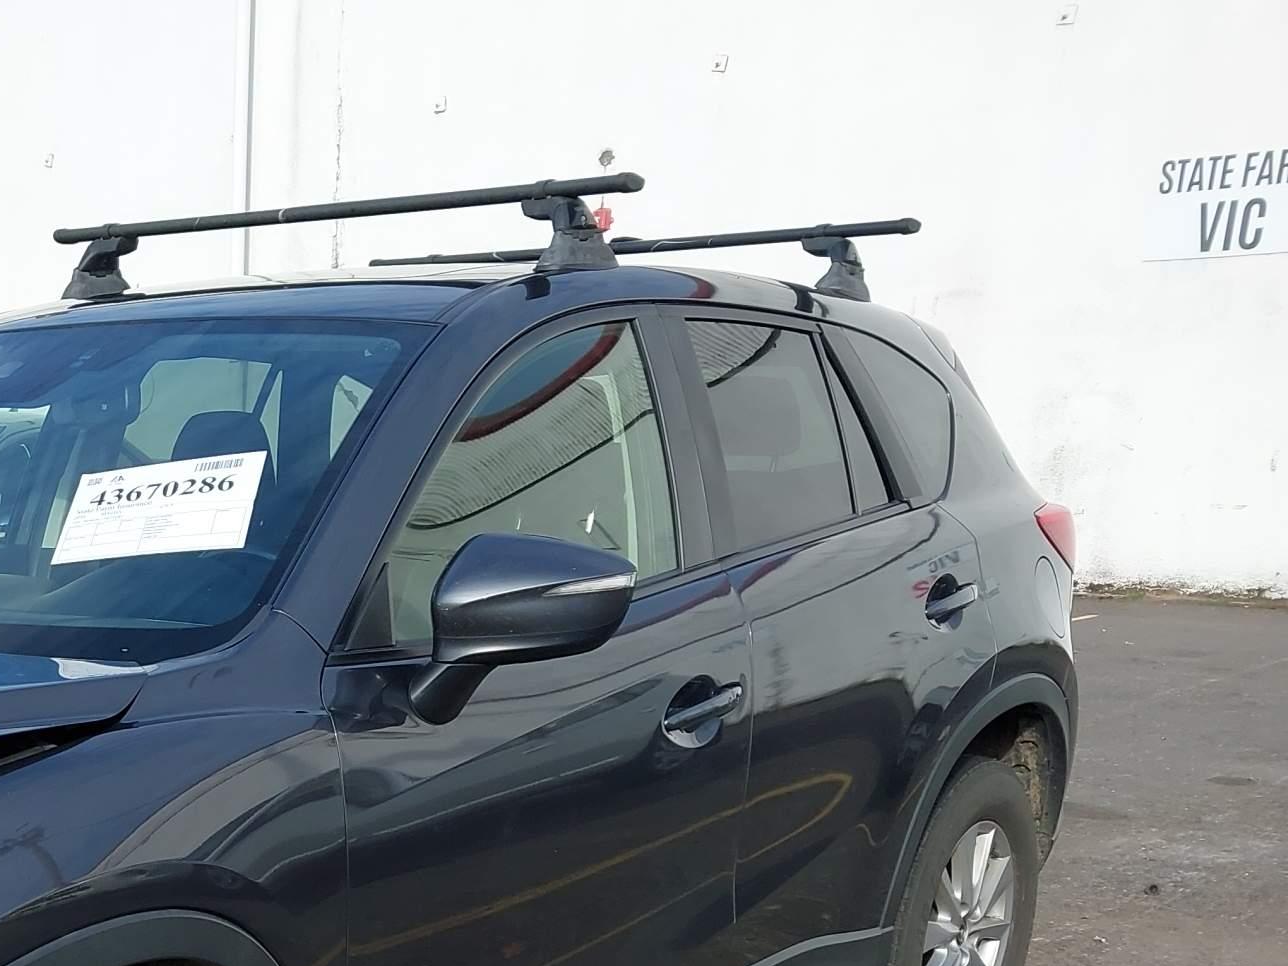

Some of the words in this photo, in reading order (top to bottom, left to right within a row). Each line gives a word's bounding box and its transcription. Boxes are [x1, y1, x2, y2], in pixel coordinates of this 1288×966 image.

[1159, 153, 1238, 195] STATE
[1199, 197, 1268, 253] VIC
[89, 473, 238, 506] 43670286
